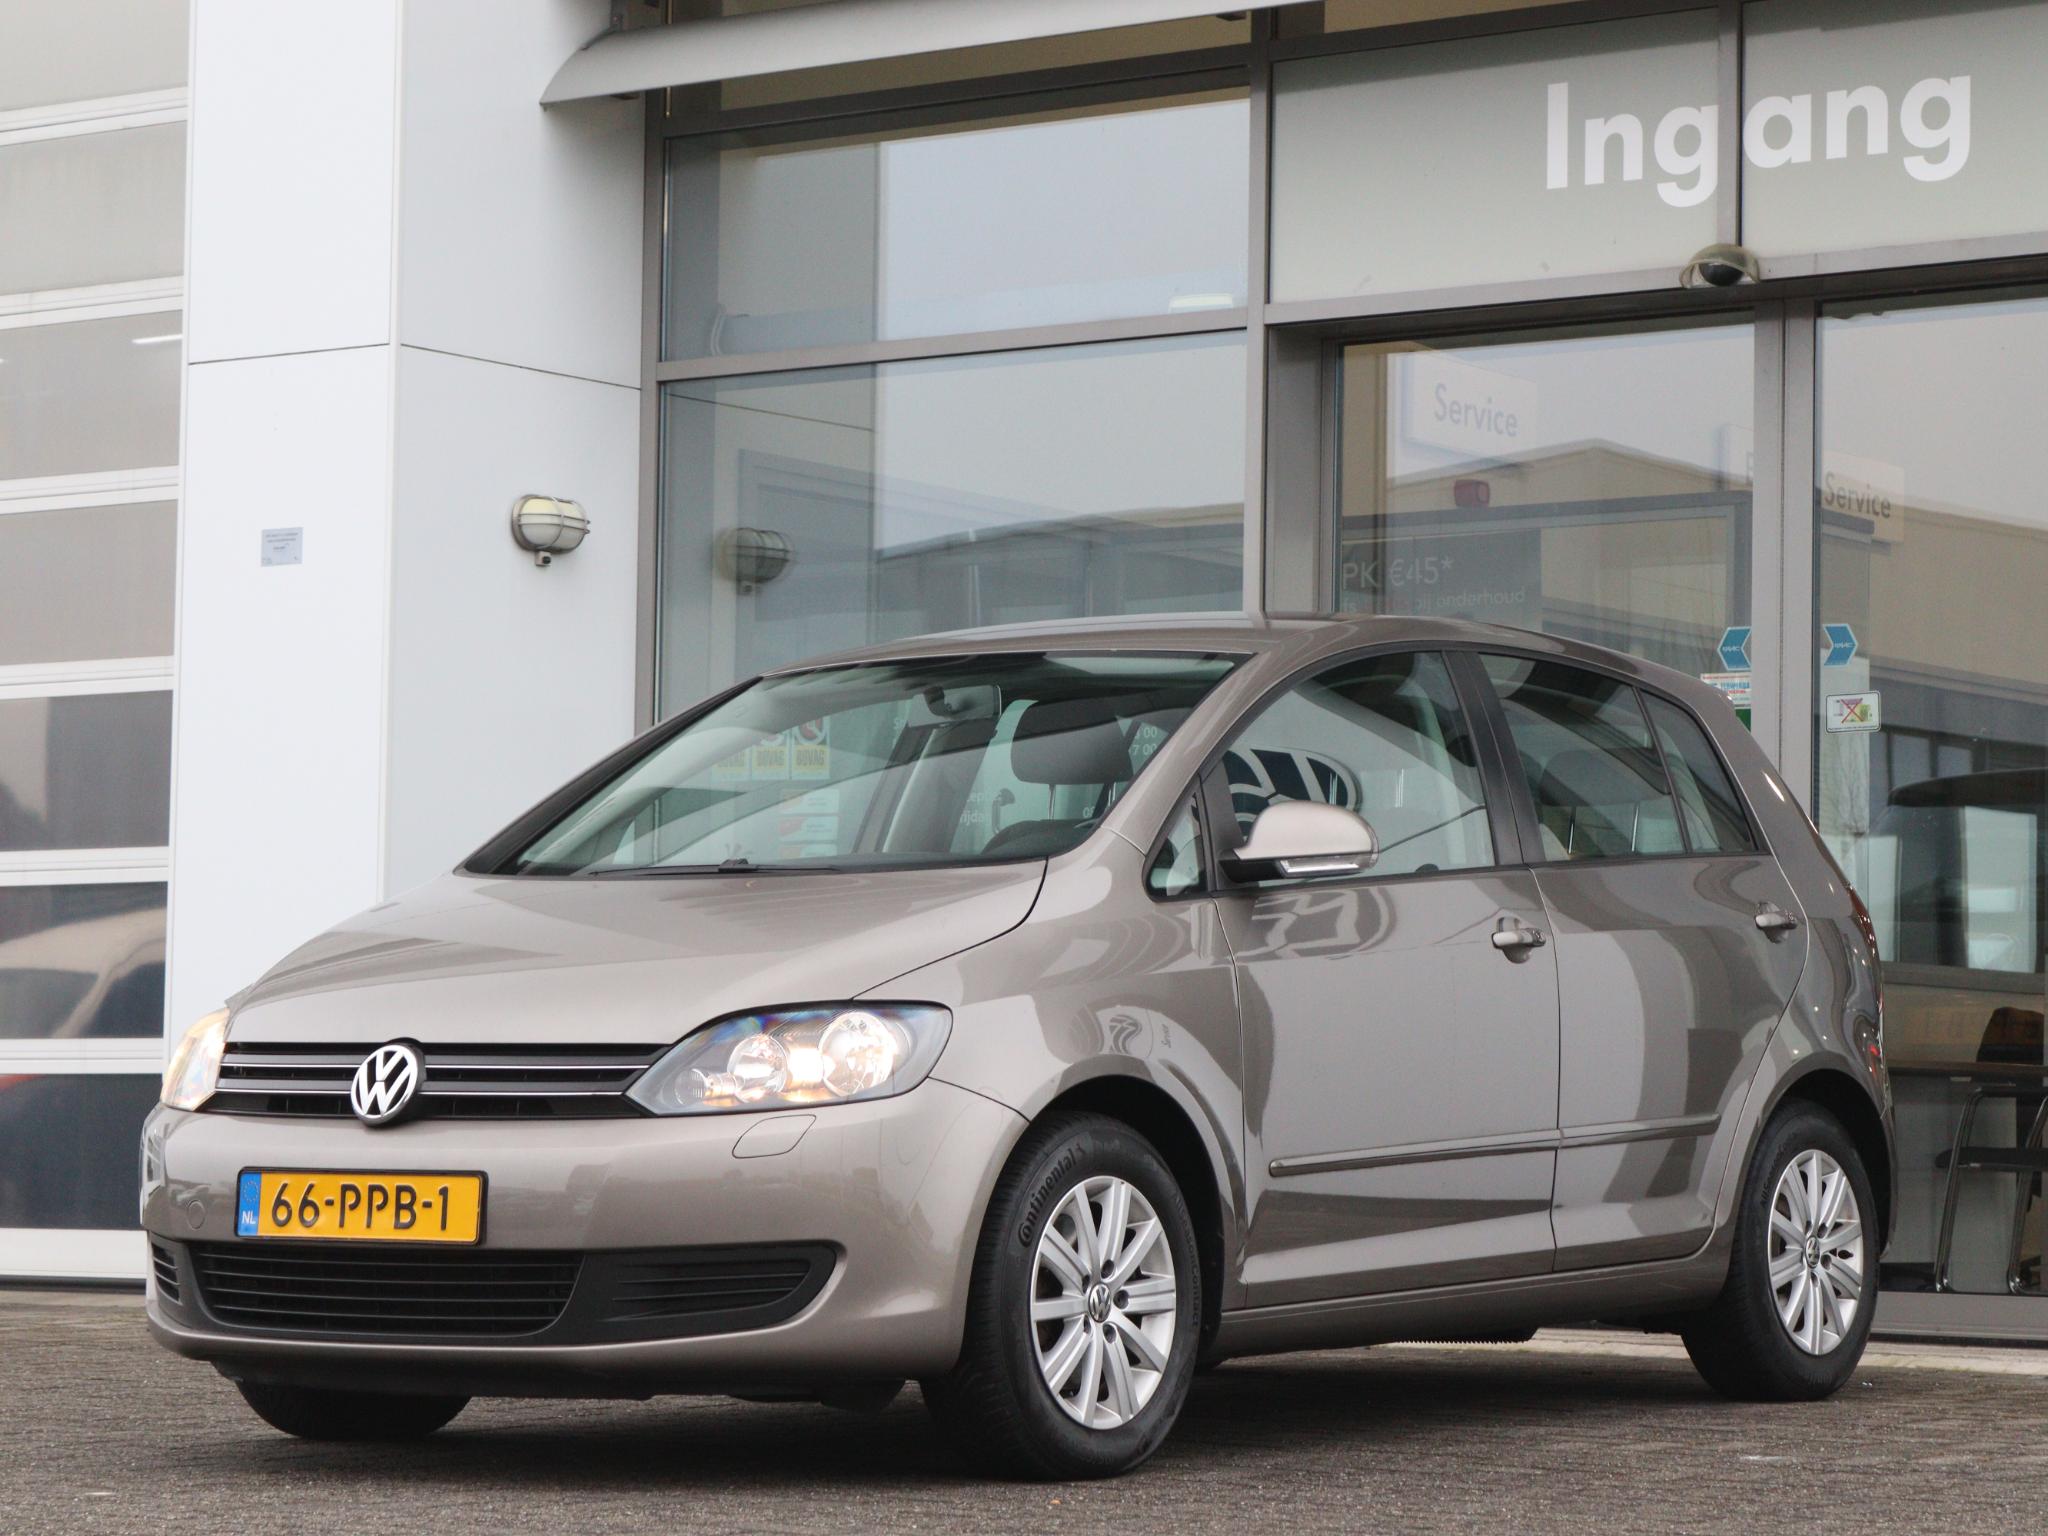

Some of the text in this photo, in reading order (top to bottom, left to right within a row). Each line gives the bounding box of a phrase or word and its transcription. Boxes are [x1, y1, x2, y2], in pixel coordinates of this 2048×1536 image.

[1545, 75, 1972, 208] Ingang
[1433, 382, 1520, 438] Service
[1823, 469, 1892, 519] Service
[1436, 586, 1526, 610] onderhoud
[242, 1209, 257, 1225] NL
[272, 1182, 450, 1231] 66-PPB-1
[1018, 1147, 1078, 1248] Continental
